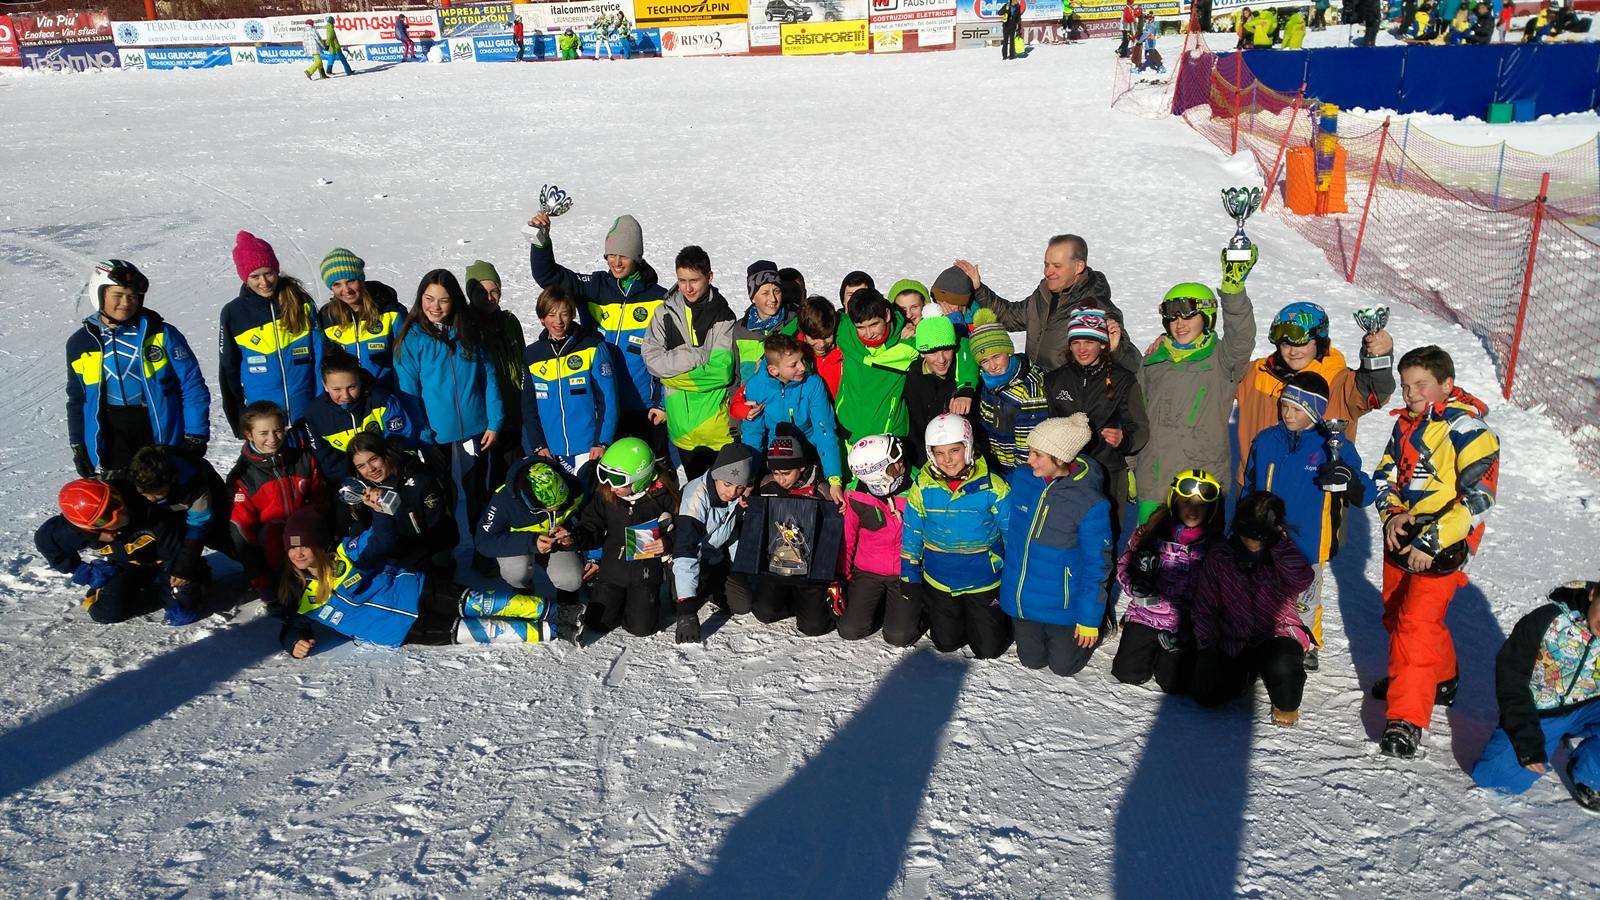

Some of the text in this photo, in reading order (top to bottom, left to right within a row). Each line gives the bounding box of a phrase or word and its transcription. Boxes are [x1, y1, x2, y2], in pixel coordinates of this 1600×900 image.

[438, 5, 512, 17] IMPRESA EDILE
[872, 10, 954, 22] COSTRUZIONI ELETTRICHE
[36, 16, 53, 28] Vin
[444, 14, 508, 25] COSTRUZIONI
[144, 22, 178, 31] TERME
[188, 20, 236, 31] COMANO
[25, 30, 55, 40] Enoteca
[61, 28, 76, 37] Vini
[77, 26, 98, 36] sfusi
[476, 40, 494, 48] VALLI
[147, 52, 166, 60] VALLI
[167, 51, 208, 60] GIUDICARIE
[368, 46, 387, 55] VALLI
[482, 510, 496, 532] Audi
